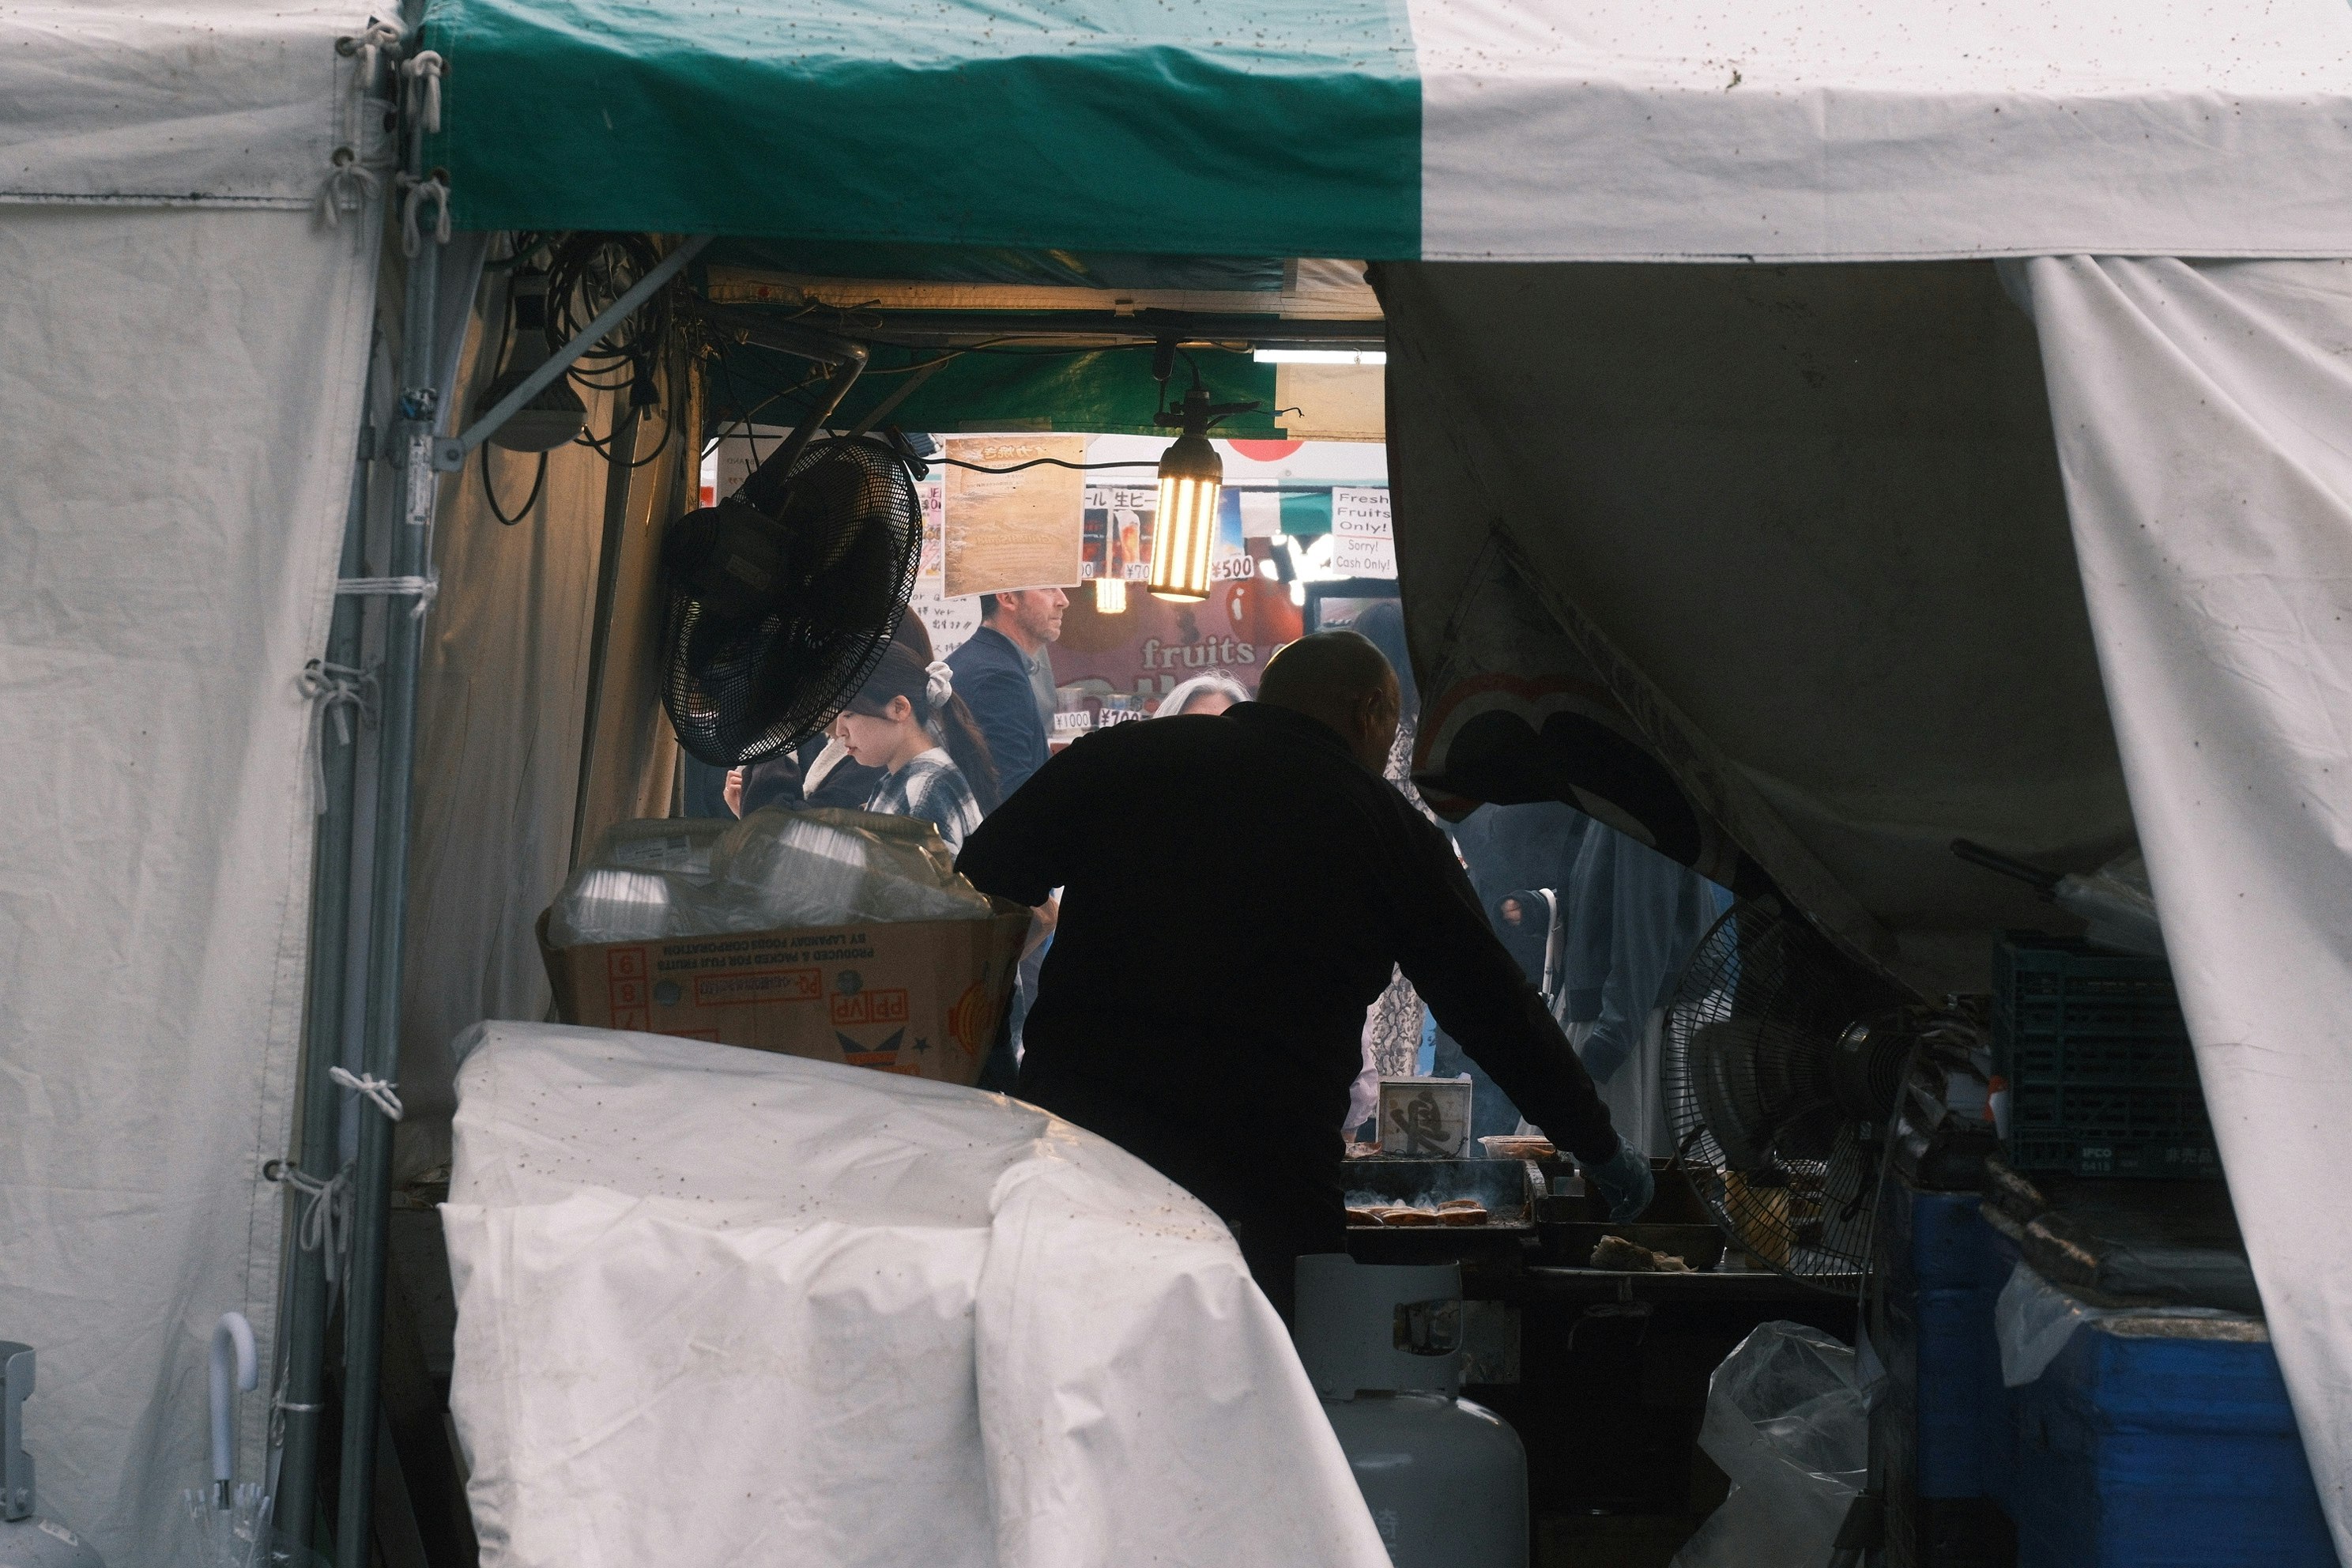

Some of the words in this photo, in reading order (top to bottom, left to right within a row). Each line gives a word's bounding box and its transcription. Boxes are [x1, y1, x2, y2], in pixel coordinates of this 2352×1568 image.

[1339, 493, 1389, 504] Fresh
[1337, 507, 1391, 518] Fruits
[1340, 521, 1387, 534] Only!
[1348, 539, 1378, 554] Sorry!
[1212, 557, 1252, 578] ¥500
[1336, 555, 1361, 568] Cash
[1364, 557, 1391, 573] Only!
[1142, 635, 1255, 669] fruits
[1056, 712, 1089, 729] ¥1000
[850, 933, 866, 944] BY
[662, 940, 749, 956] CORPORATION
[813, 948, 874, 961] PRODUCED
[728, 955, 752, 966] FOR
[754, 952, 798, 964] PACKED
[2081, 1147, 2113, 1159] IFCO
